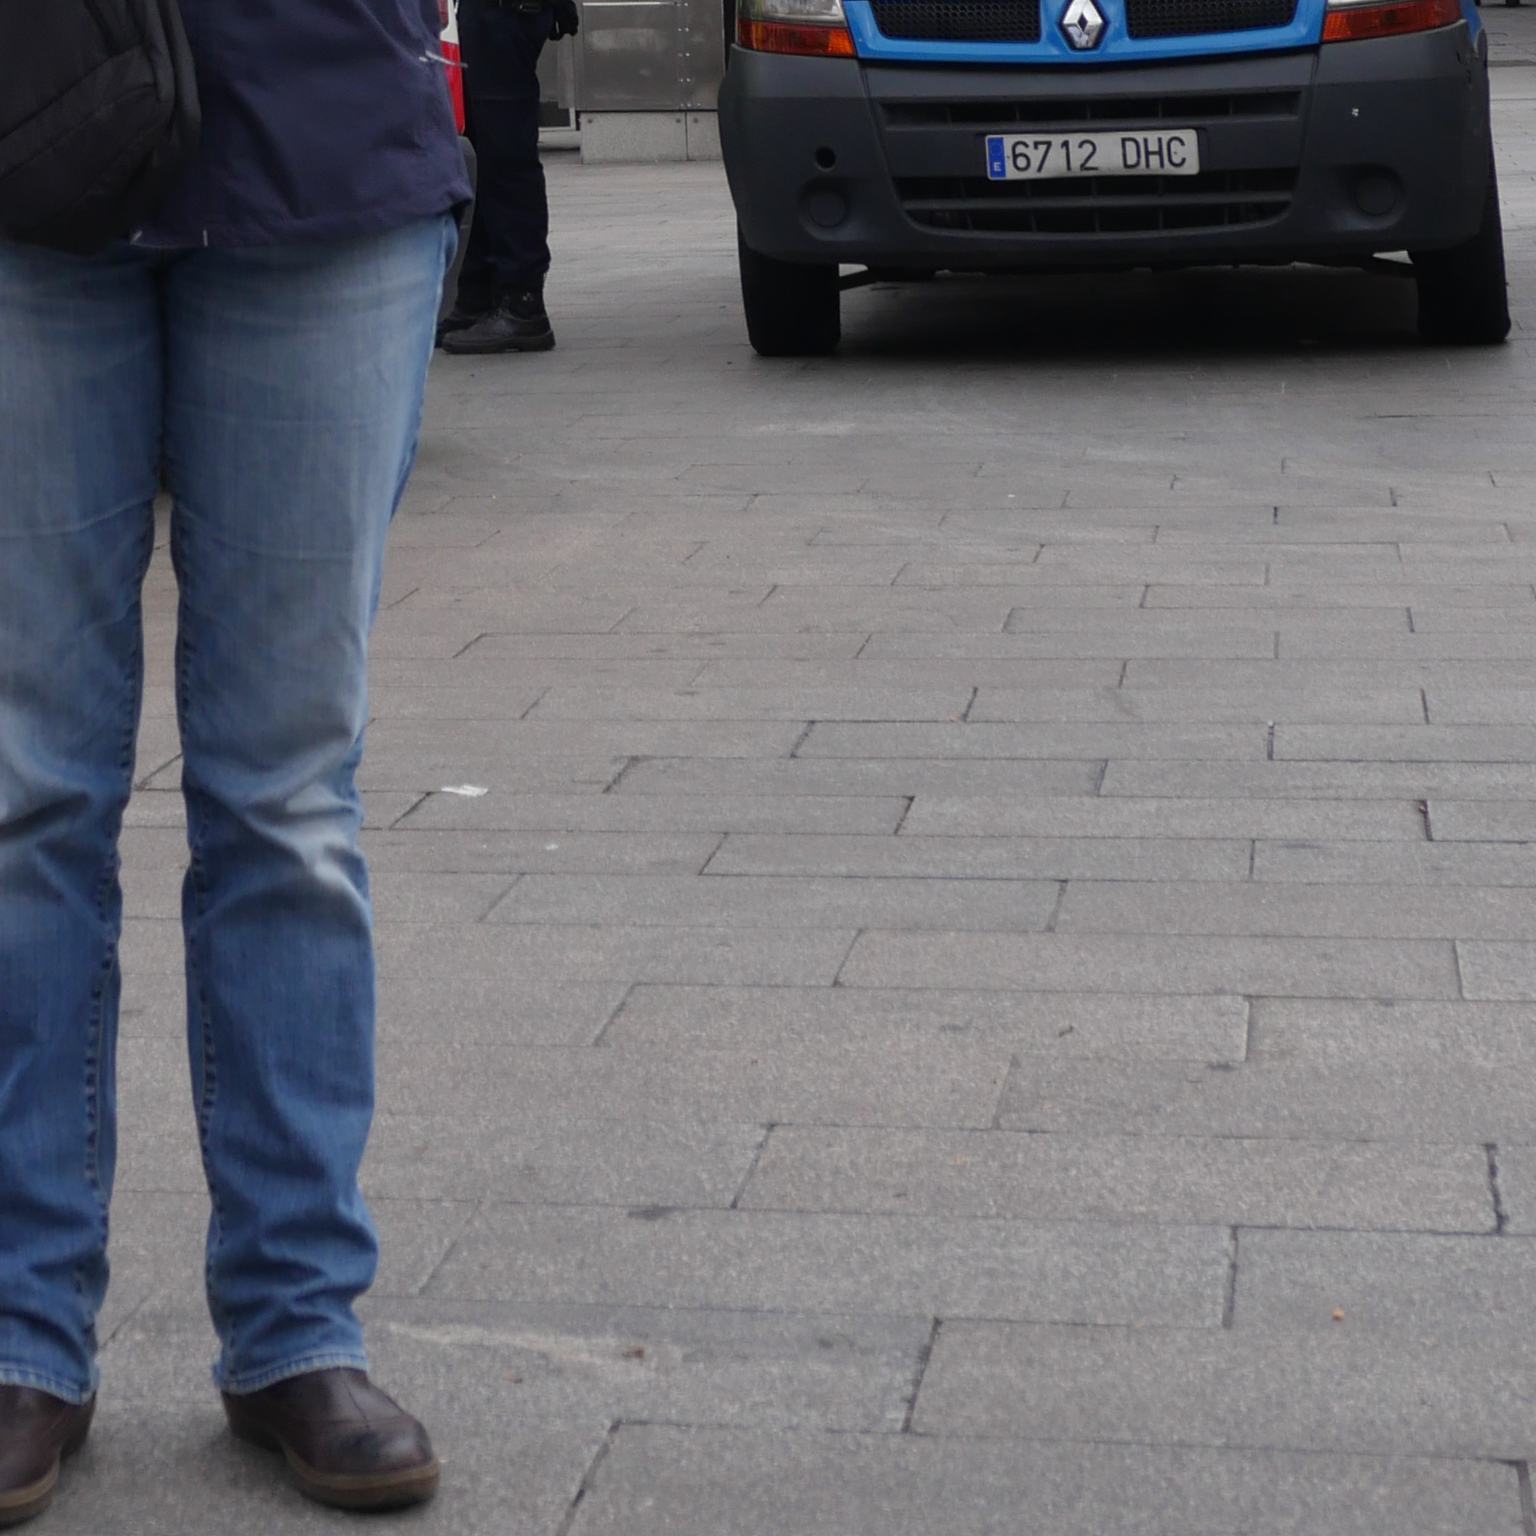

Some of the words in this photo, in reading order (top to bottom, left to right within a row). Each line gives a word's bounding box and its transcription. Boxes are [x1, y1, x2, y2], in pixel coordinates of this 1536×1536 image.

[993, 161, 1002, 172] E
[1010, 139, 1099, 174] 6712
[1120, 136, 1187, 170] DHC
